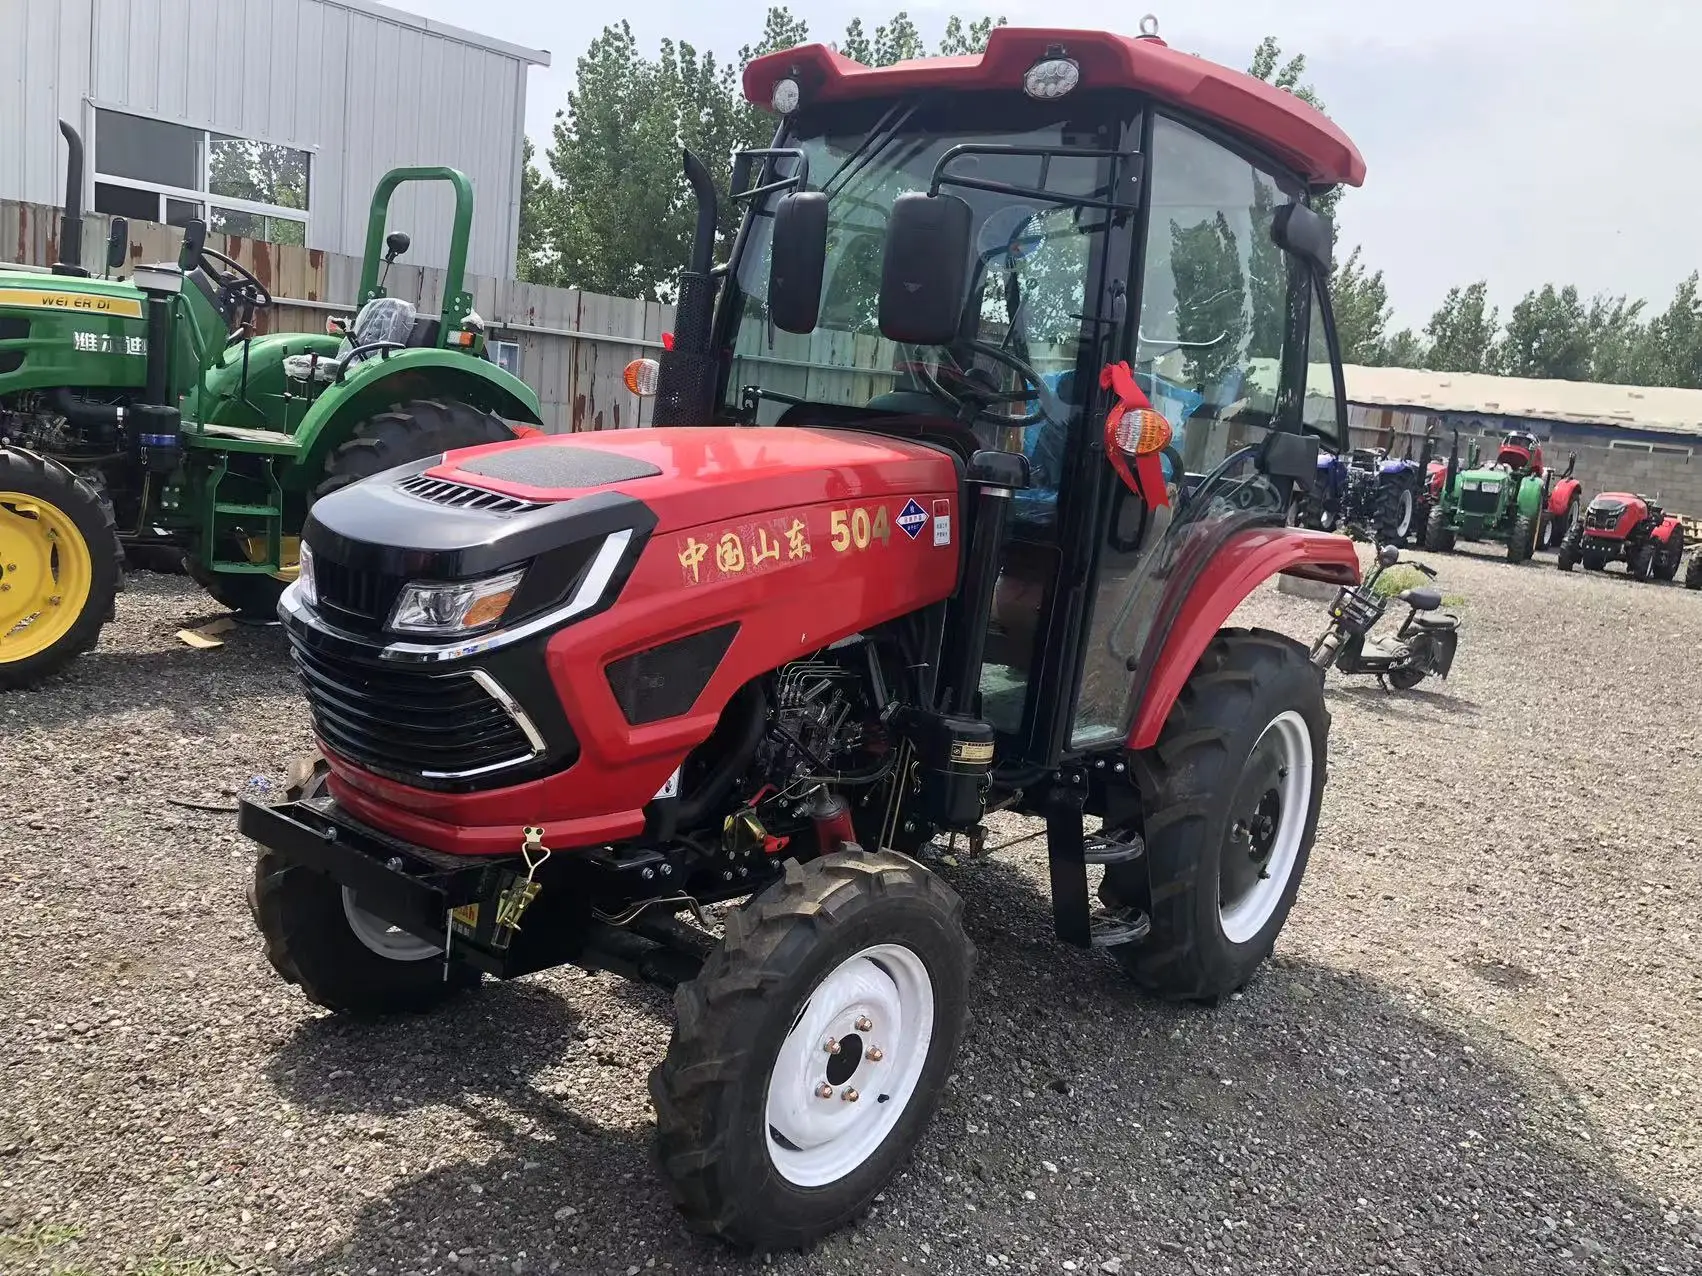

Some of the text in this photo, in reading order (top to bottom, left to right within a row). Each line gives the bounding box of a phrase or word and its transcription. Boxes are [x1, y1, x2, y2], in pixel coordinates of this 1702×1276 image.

[42, 295, 110, 310] WEI ER DI
[678, 519, 811, 583] 中国山东
[830, 505, 890, 552] 504
